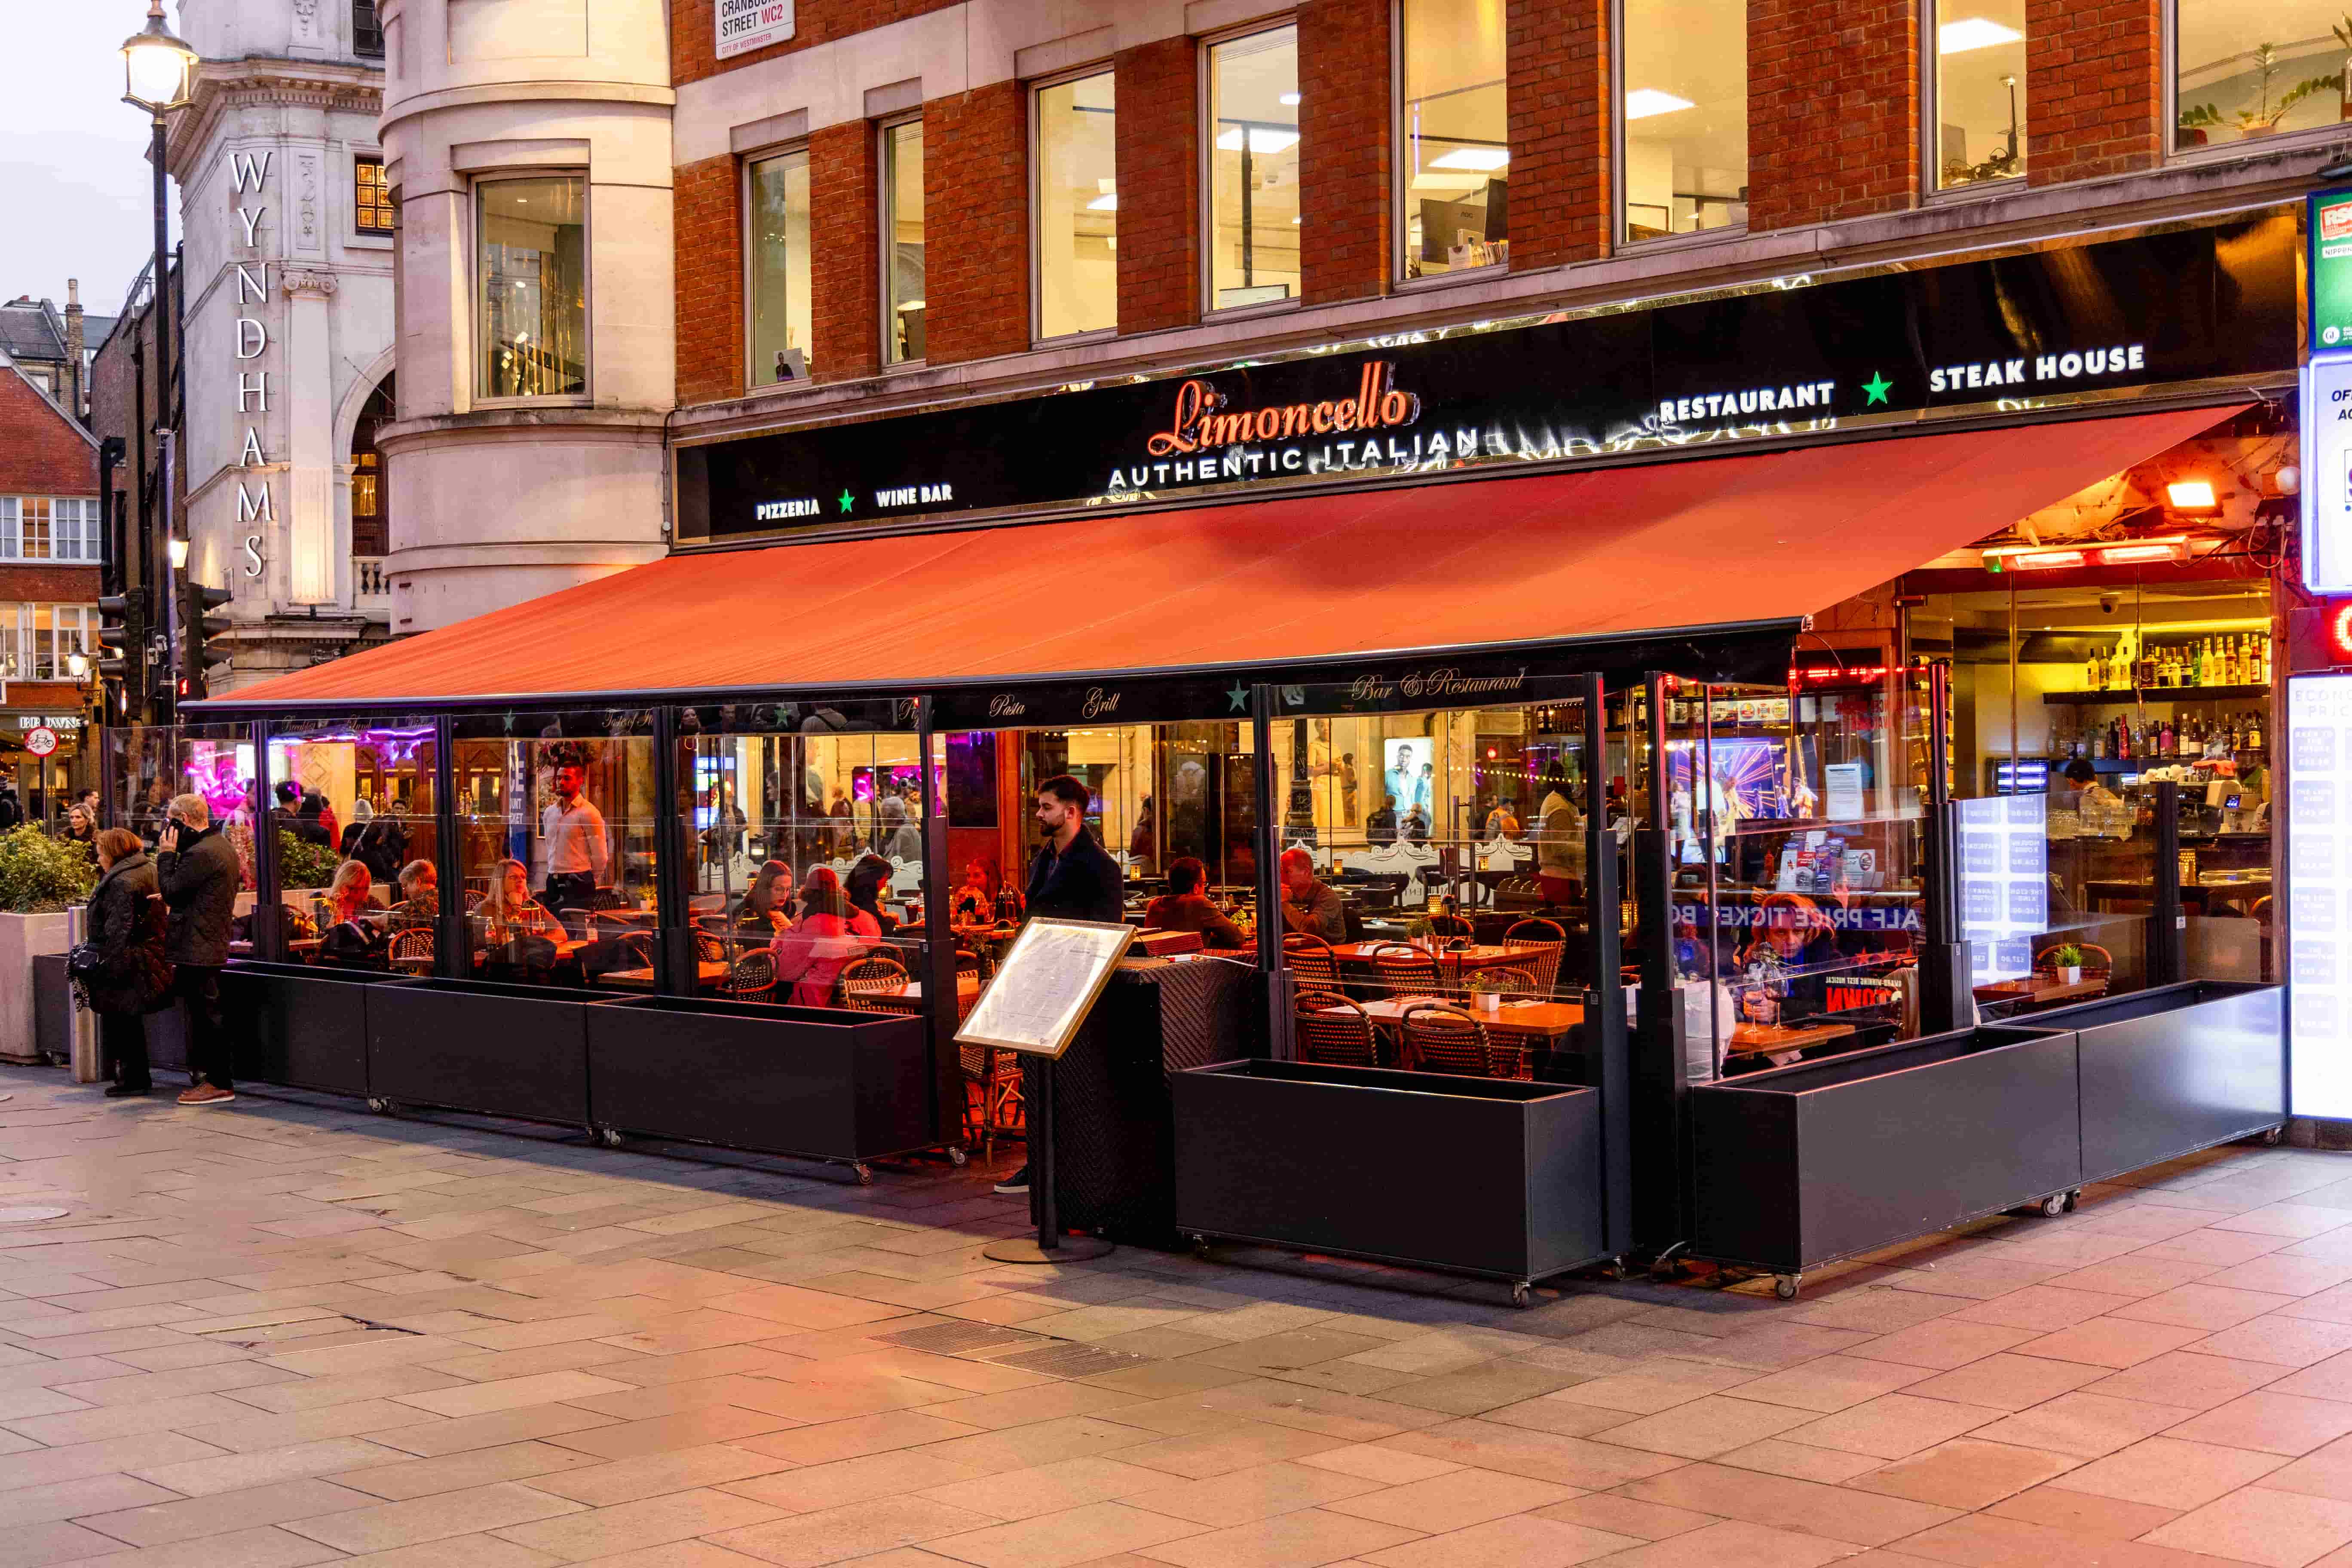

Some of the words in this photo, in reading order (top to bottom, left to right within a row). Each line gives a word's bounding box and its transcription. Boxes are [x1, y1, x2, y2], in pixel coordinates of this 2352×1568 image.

[722, 12, 758, 36] STREET
[761, 4, 783, 24] WC2
[722, 45, 731, 54] CITY
[740, 33, 772, 48] WESTMINSTER
[229, 152, 274, 576] WYNDHAMS
[1929, 359, 2025, 392] STEAK
[2036, 345, 2145, 380] HOUSE
[1148, 361, 1413, 456] Limoncello
[1660, 382, 1835, 423] RESTAURANT
[1109, 449, 1302, 487] AUTHENTIC
[1324, 429, 1477, 467] ITALIAN
[756, 499, 821, 521] PIZZERIA
[876, 488, 917, 508] WINE
[921, 484, 953, 503] BAR
[1351, 674, 1393, 700] Bar
[1400, 671, 1423, 697] &
[1426, 668, 1525, 695] Restaurant
[989, 694, 1026, 717] Pasta
[1083, 687, 1121, 719] Grill
